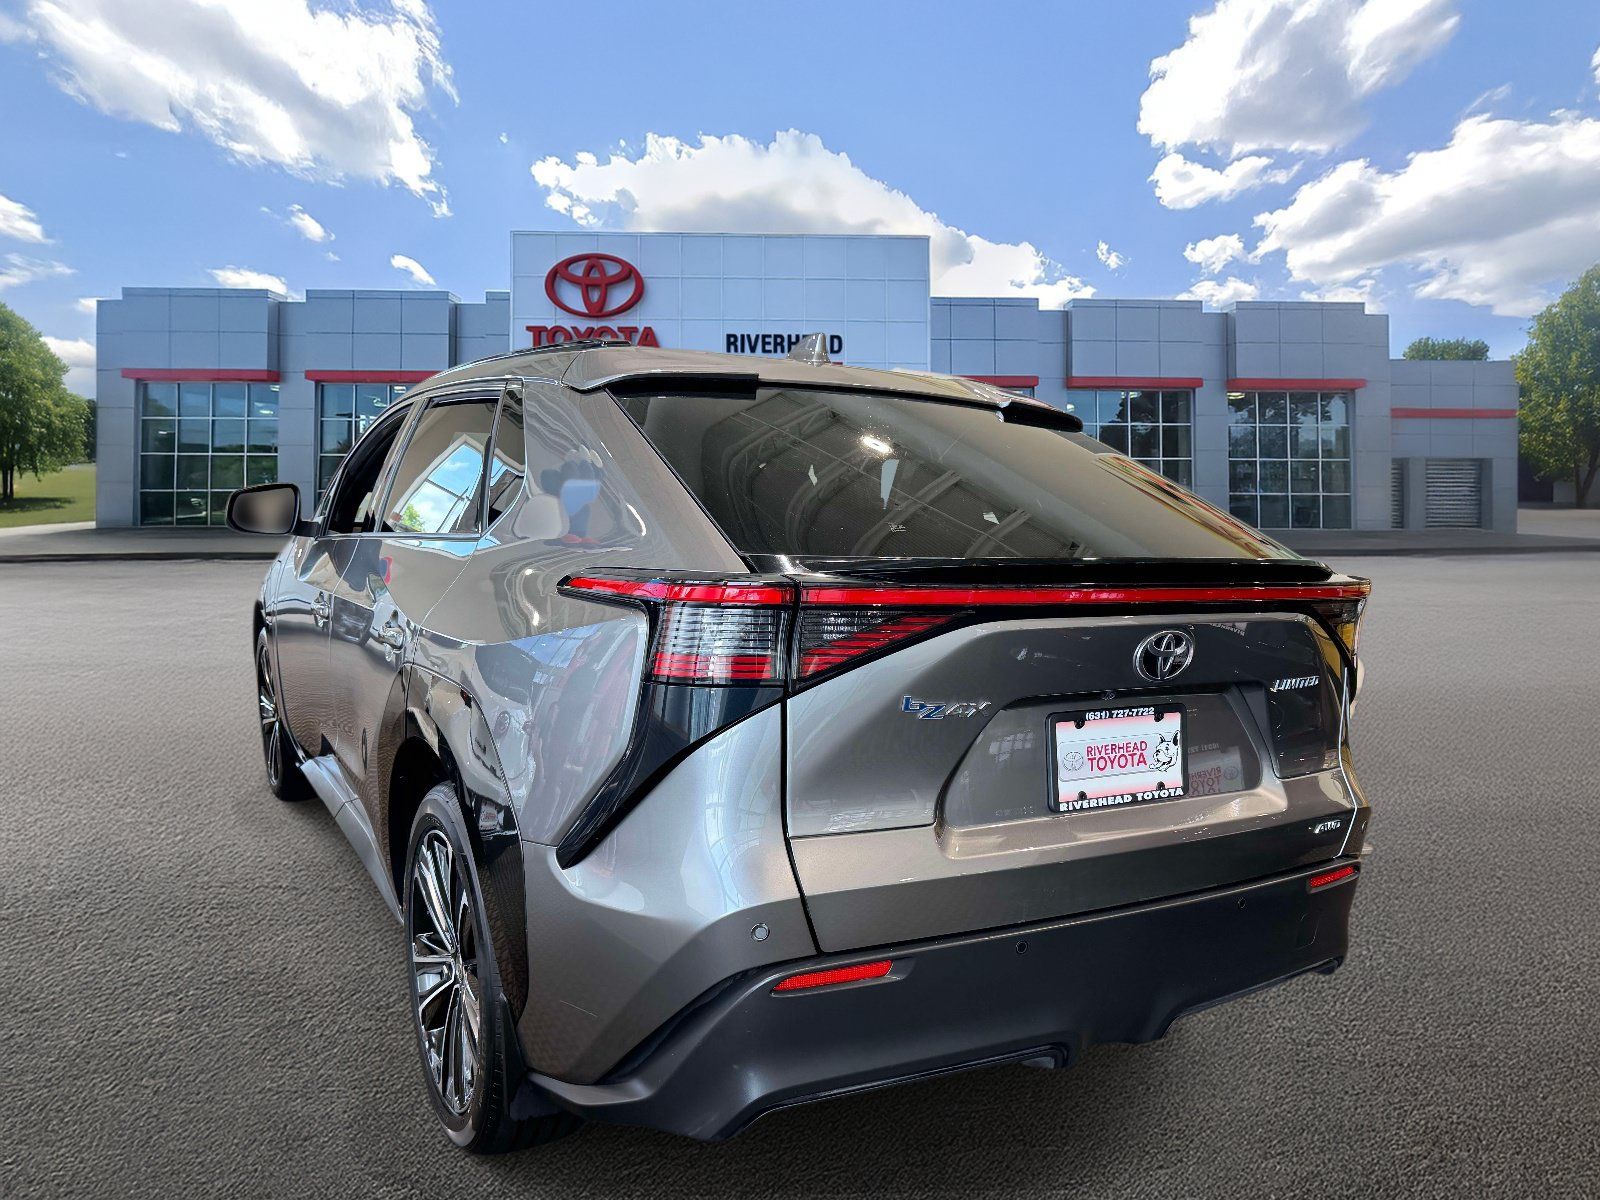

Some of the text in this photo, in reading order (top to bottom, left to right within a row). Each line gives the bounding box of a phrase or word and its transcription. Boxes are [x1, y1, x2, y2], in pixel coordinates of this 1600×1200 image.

[526, 325, 660, 347] TOYOTA
[726, 333, 843, 354] RIVERHD
[1085, 707, 1155, 721] (631) 727-7722
[1086, 741, 1148, 758] RIVERHEAD
[1087, 753, 1148, 772] TOYOTA
[1060, 787, 1184, 812] RIVERHEAD TOYOTA
